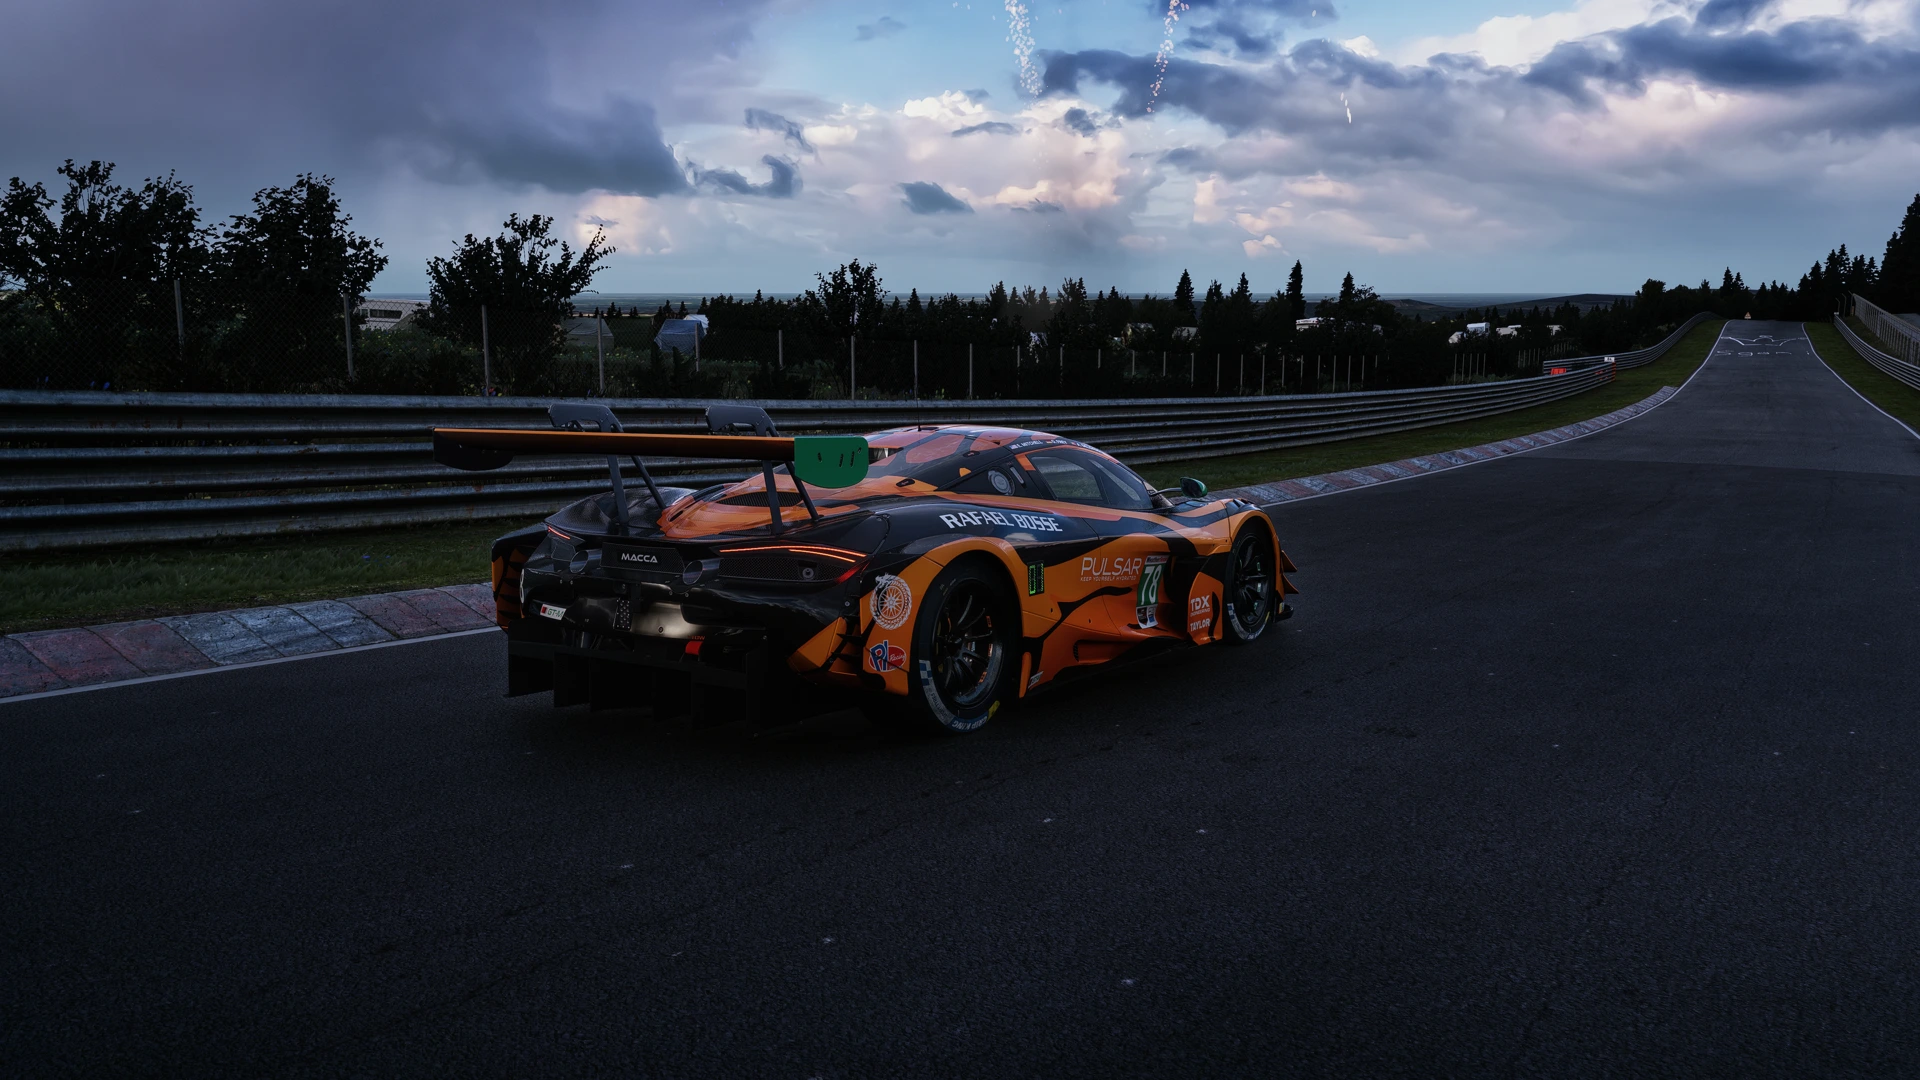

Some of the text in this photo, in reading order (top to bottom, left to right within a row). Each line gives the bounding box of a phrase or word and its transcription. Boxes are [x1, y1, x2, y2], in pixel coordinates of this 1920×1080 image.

[939, 511, 1063, 532] RAFAEL BOSSE
[621, 552, 659, 564] MACCA
[1081, 557, 1142, 576] PULSAR
[1140, 565, 1162, 605] 78
[1190, 595, 1210, 611] TDX
[1190, 618, 1211, 632] TAYLOR
[951, 719, 972, 731] KING
